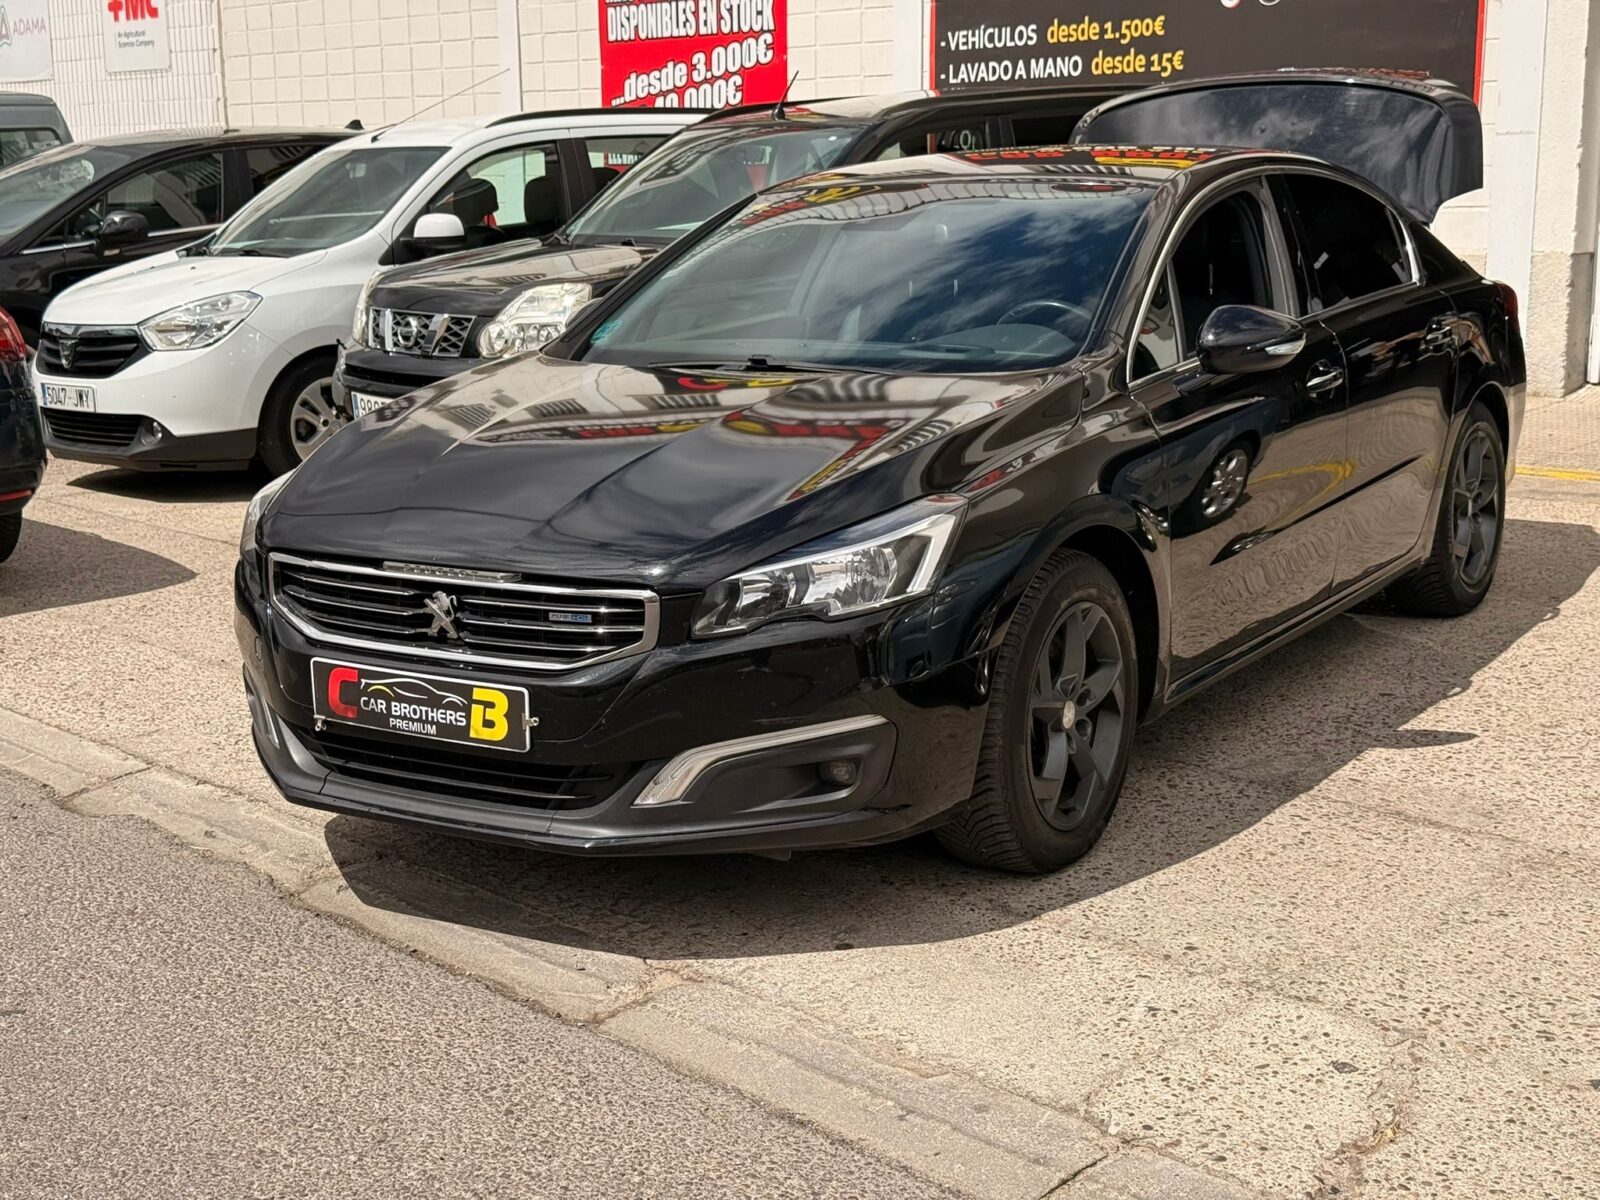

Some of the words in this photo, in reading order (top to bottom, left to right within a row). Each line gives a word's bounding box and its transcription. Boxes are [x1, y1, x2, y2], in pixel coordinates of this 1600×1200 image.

[13, 17, 47, 36] ADAMA
[607, 0, 696, 42] DISPONIBLES
[701, 0, 718, 35] EN
[720, 0, 775, 34] STOCK
[948, 24, 1038, 51] VEHÍCULOS
[1047, 16, 1100, 44] desde
[1103, 15, 1165, 45] 1.500€
[691, 32, 774, 83] 3.000€
[949, 61, 1012, 84] LAVADO
[1015, 59, 1027, 80] A
[1030, 55, 1083, 79] MANO
[1091, 48, 1146, 76] desde
[1150, 50, 1184, 78] 15€
[328, 666, 359, 719] C
[360, 696, 387, 714] CAR
[391, 701, 467, 727] BROTHERS
[389, 717, 437, 736] PREMIUM
